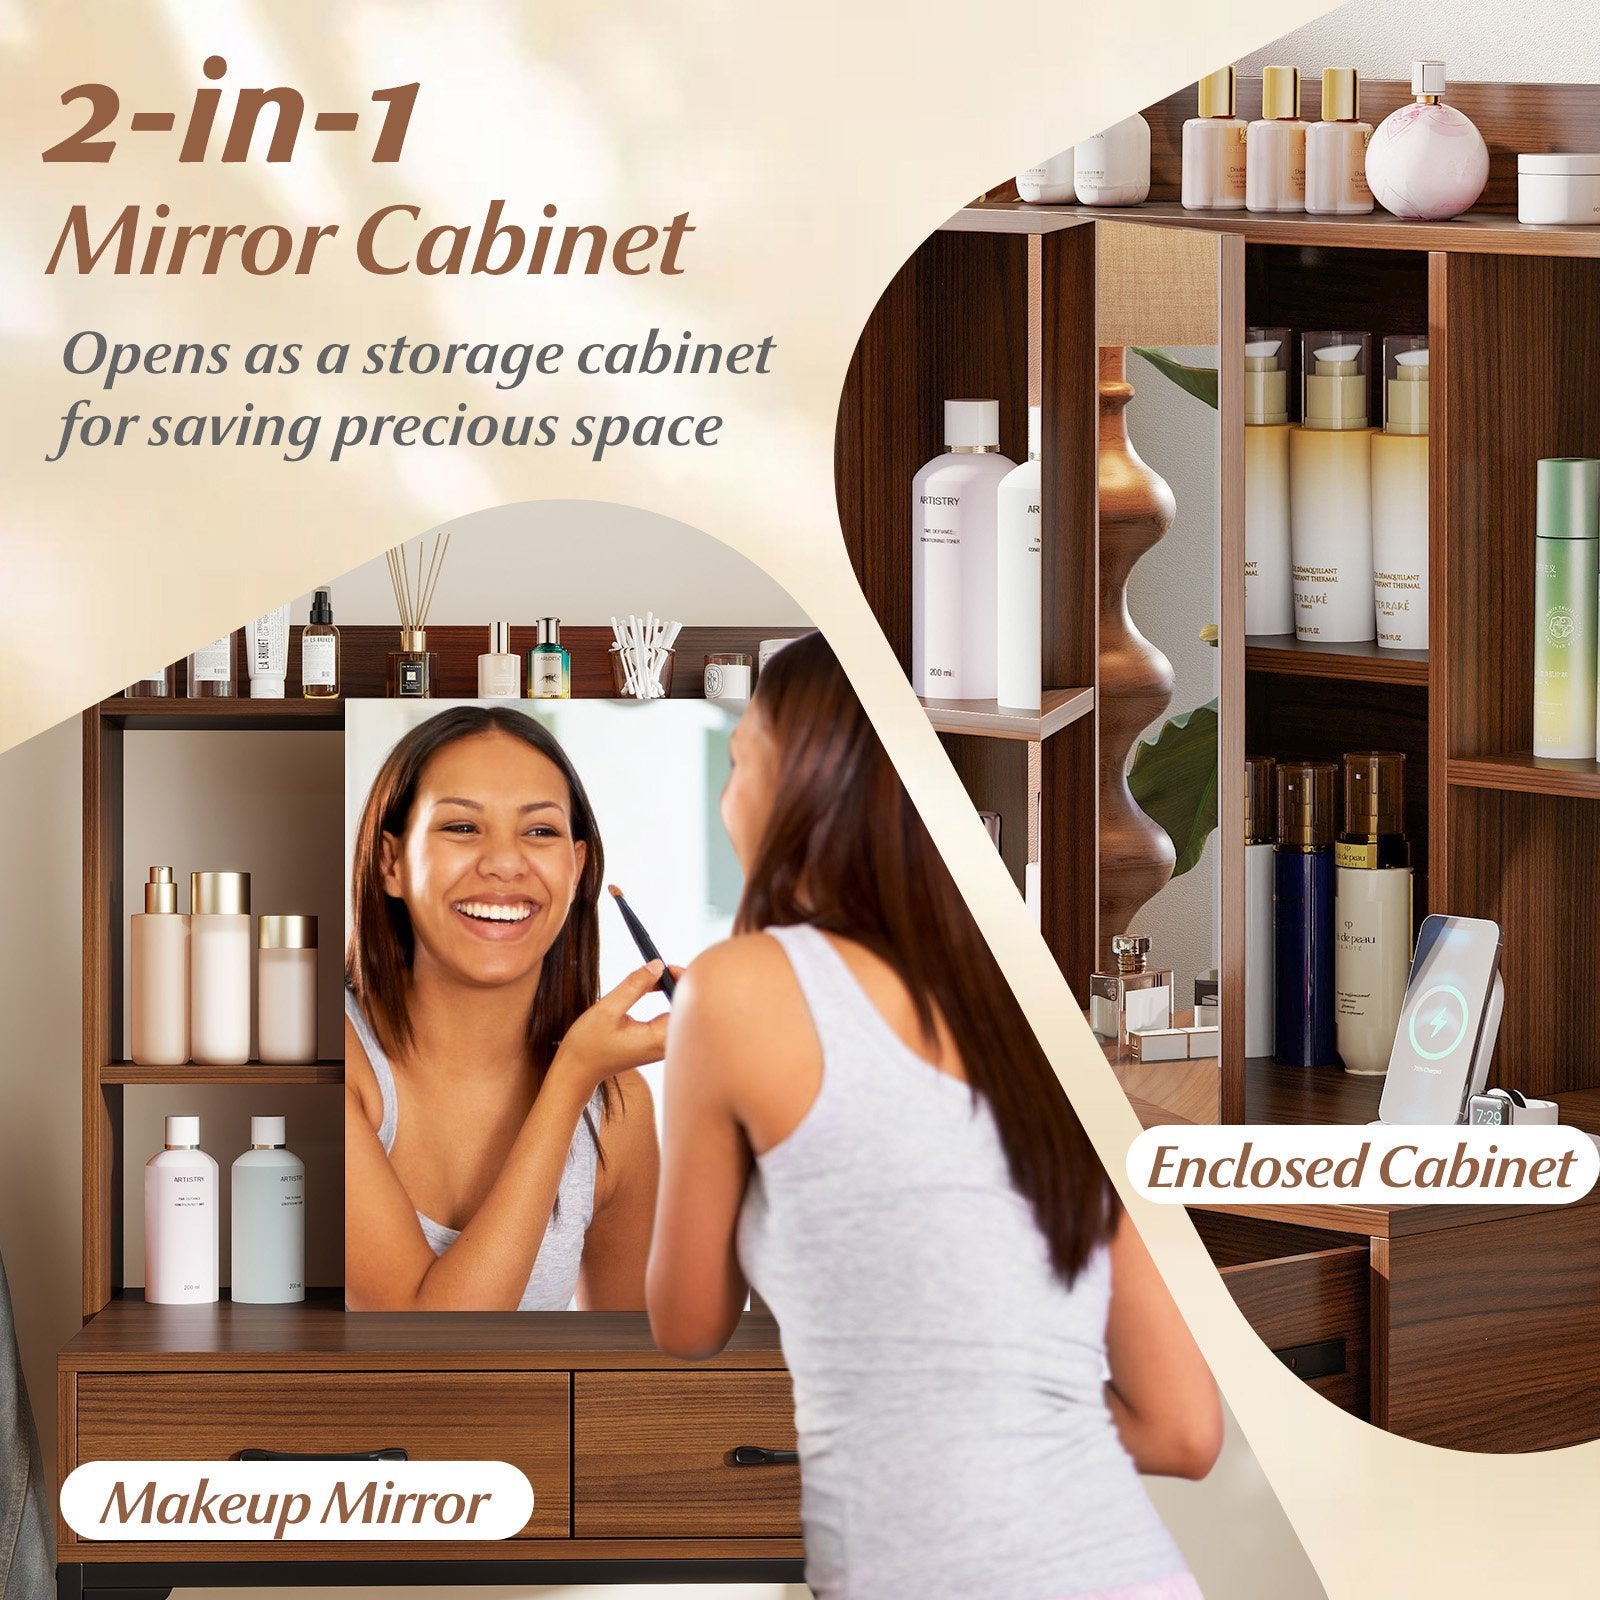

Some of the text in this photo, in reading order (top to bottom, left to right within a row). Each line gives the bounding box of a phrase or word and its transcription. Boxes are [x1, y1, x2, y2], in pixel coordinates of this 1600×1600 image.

[919, 496, 961, 506] ARTISTRY
[929, 668, 942, 677] 200
[1351, 935, 1376, 946] peau
[1476, 1108, 1502, 1125] 7:29
[173, 1175, 205, 1183] ARTISTRY
